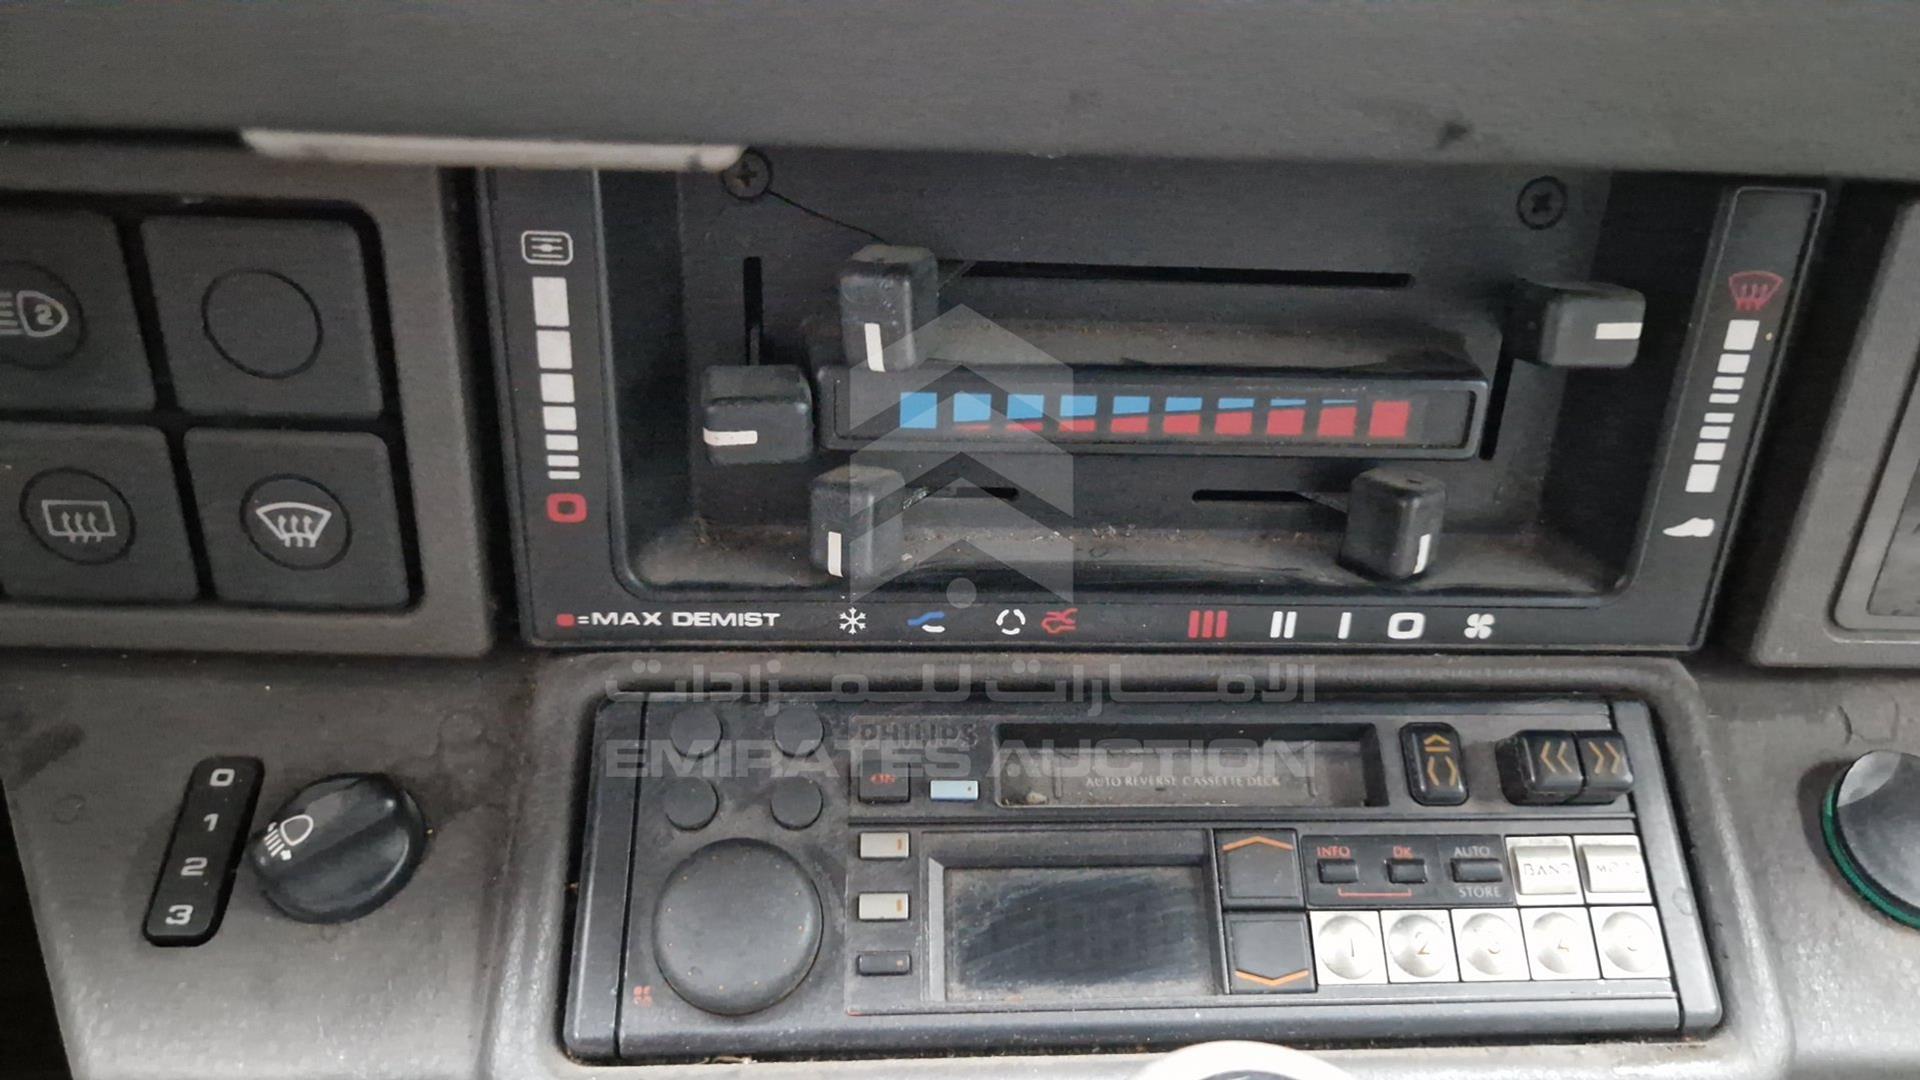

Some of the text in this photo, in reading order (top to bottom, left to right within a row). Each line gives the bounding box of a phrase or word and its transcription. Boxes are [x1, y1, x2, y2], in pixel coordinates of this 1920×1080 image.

[671, 612, 781, 627] DEMIST
[1085, 775, 1281, 787] AUTO REVERSE CASSETTE DECK
[203, 813, 220, 832] 1
[1316, 845, 1351, 857] INFO
[1454, 846, 1490, 857] AUTO
[180, 856, 208, 877] 2
[1458, 885, 1502, 898] STORE
[165, 904, 194, 925] 3
